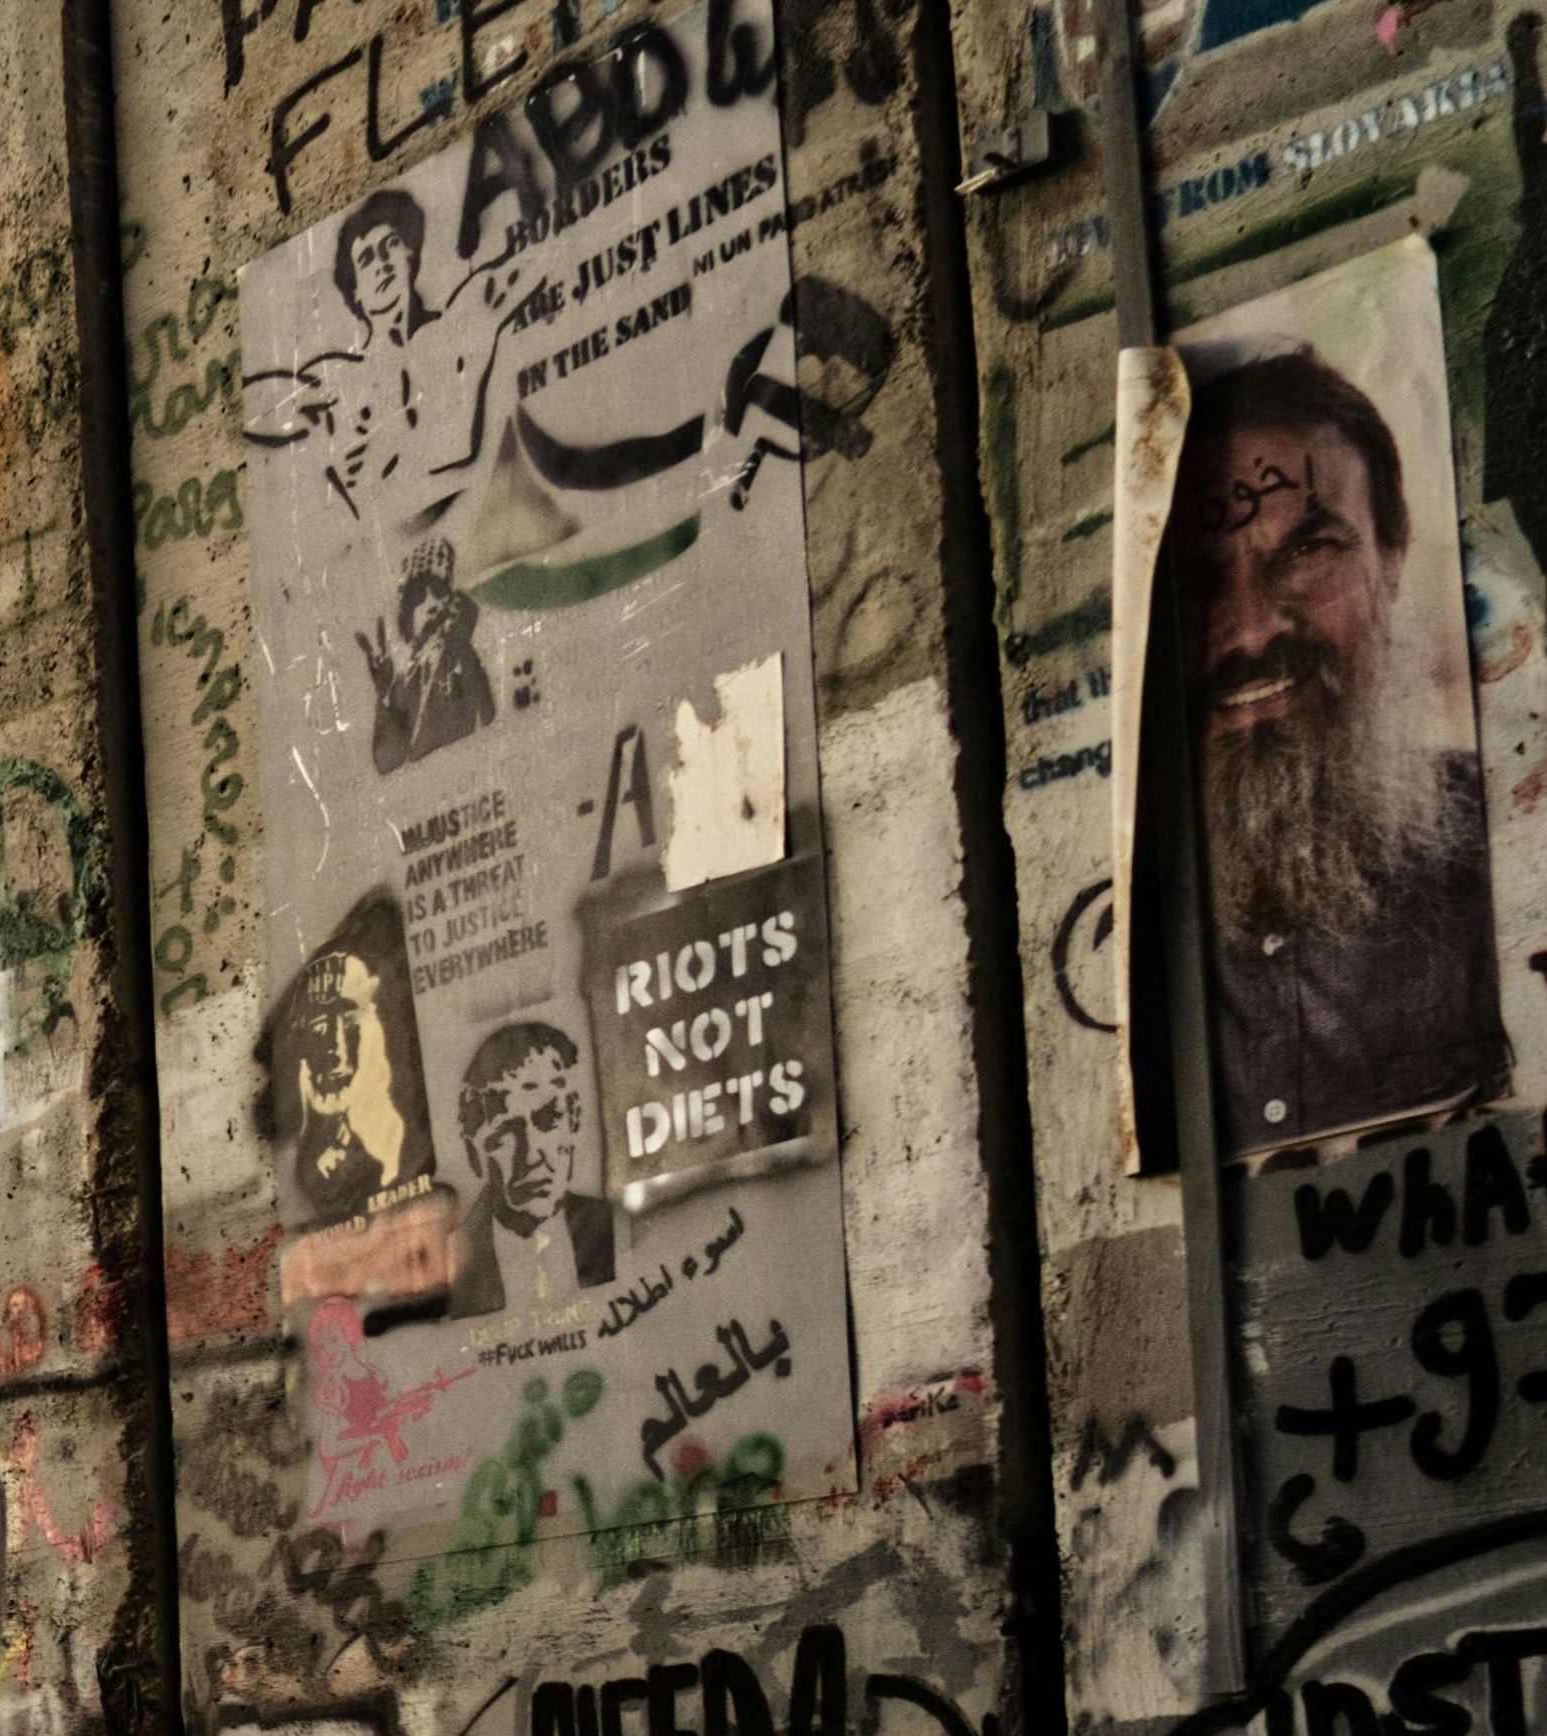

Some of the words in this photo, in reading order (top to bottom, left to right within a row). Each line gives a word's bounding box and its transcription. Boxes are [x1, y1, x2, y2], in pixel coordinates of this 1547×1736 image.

[505, 135, 671, 258] BORDERS
[571, 219, 661, 304] JUST
[666, 153, 777, 246] LINES
[719, 228, 751, 264] UN
[516, 358, 548, 400] IN
[552, 326, 608, 378] THE
[615, 282, 692, 346] SAND
[401, 790, 505, 857] INJUSTICE
[405, 820, 517, 890] ANYWHERE
[408, 894, 427, 923] IS
[432, 887, 447, 917] A
[448, 853, 525, 908] THREAT
[409, 927, 436, 957] TO
[443, 888, 523, 949] JUSTICE
[412, 920, 549, 995] EVERYWHERE
[613, 910, 798, 1015] RIOTS
[644, 990, 774, 1077] NOT
[625, 1057, 805, 1159] DIETS
[537, 1328, 587, 1357] WALLS
